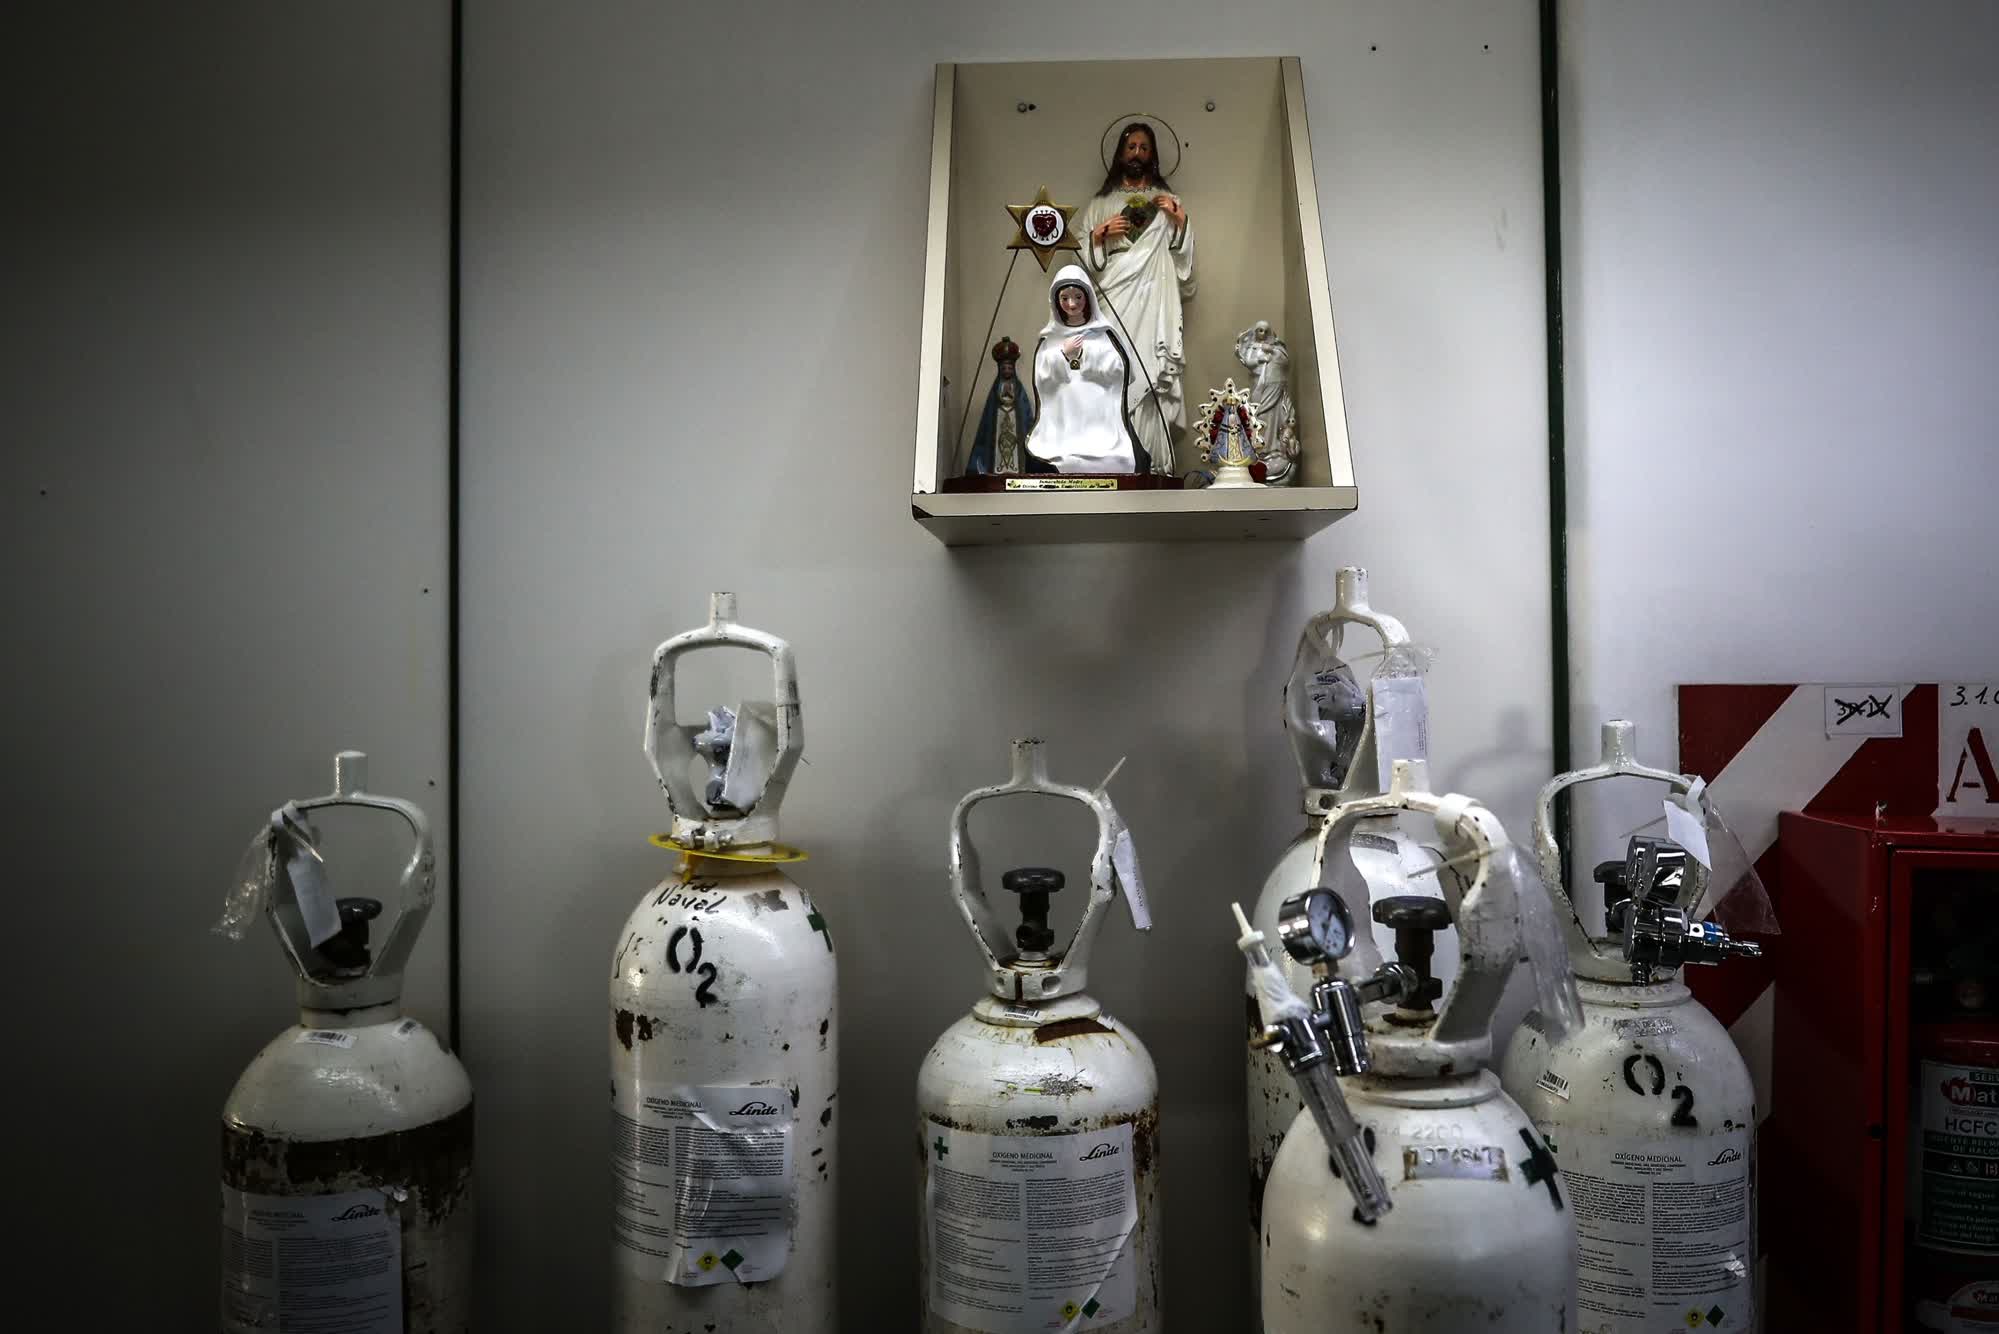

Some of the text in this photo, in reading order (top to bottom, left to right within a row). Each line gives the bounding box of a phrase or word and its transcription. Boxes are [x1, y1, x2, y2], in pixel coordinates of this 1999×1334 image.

[652, 885, 727, 914] Naval
[728, 1101, 778, 1116] Linde
[1945, 1116, 1997, 1136] HCFC
[1079, 1143, 1120, 1161] Linde
[1646, 1154, 1683, 1163] MEDICINAL
[1707, 1148, 1742, 1166] Linde
[330, 1204, 381, 1223] Linde
